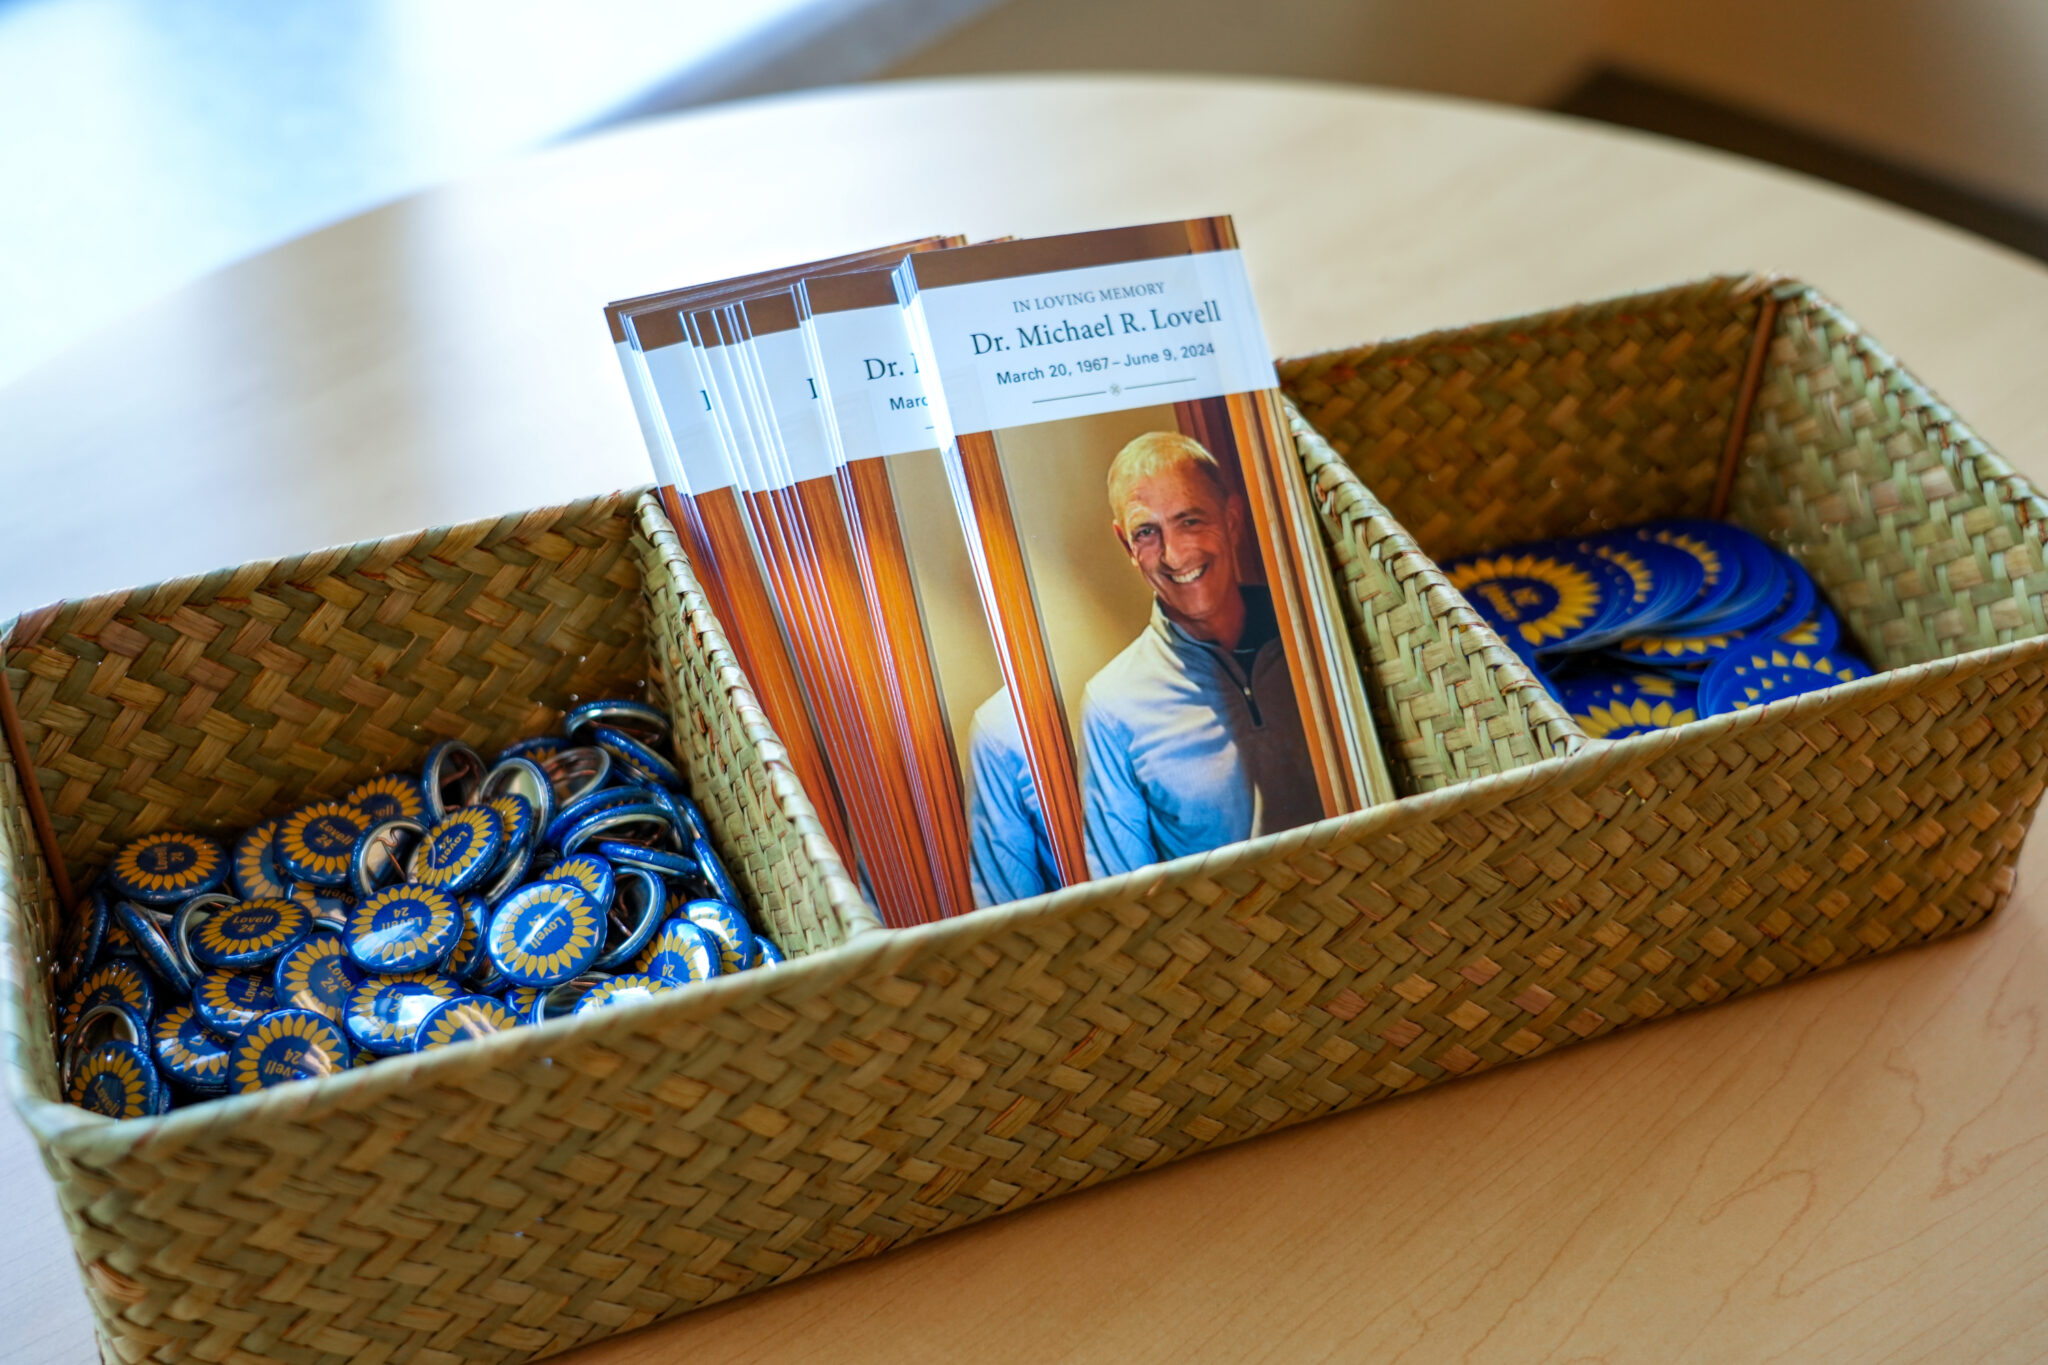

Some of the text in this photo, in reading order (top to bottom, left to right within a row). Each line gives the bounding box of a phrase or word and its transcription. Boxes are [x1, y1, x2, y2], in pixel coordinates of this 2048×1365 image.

[1012, 282, 1165, 313] IN LOVING MEMORY
[970, 300, 1222, 355] Dr. Michael R. Lovell
[864, 357, 905, 381] Dr.
[996, 367, 1045, 386] March
[1050, 363, 1072, 378] 20,
[1163, 348, 1178, 362] 9,
[1181, 342, 1215, 359] 2024
[889, 396, 929, 411] Marc
[315, 834, 334, 848] 24
[319, 819, 354, 846] Lovell
[438, 835, 453, 849] 24
[438, 830, 469, 865] Lovell
[232, 914, 275, 925] Lovell
[393, 907, 410, 919] 24
[238, 923, 256, 933] 24
[381, 916, 423, 931] Lovell
[530, 916, 567, 950] Lovell
[661, 963, 676, 978] 24
[239, 974, 263, 1003] Lovell
[320, 977, 339, 994] 24
[283, 1048, 303, 1066] 24
